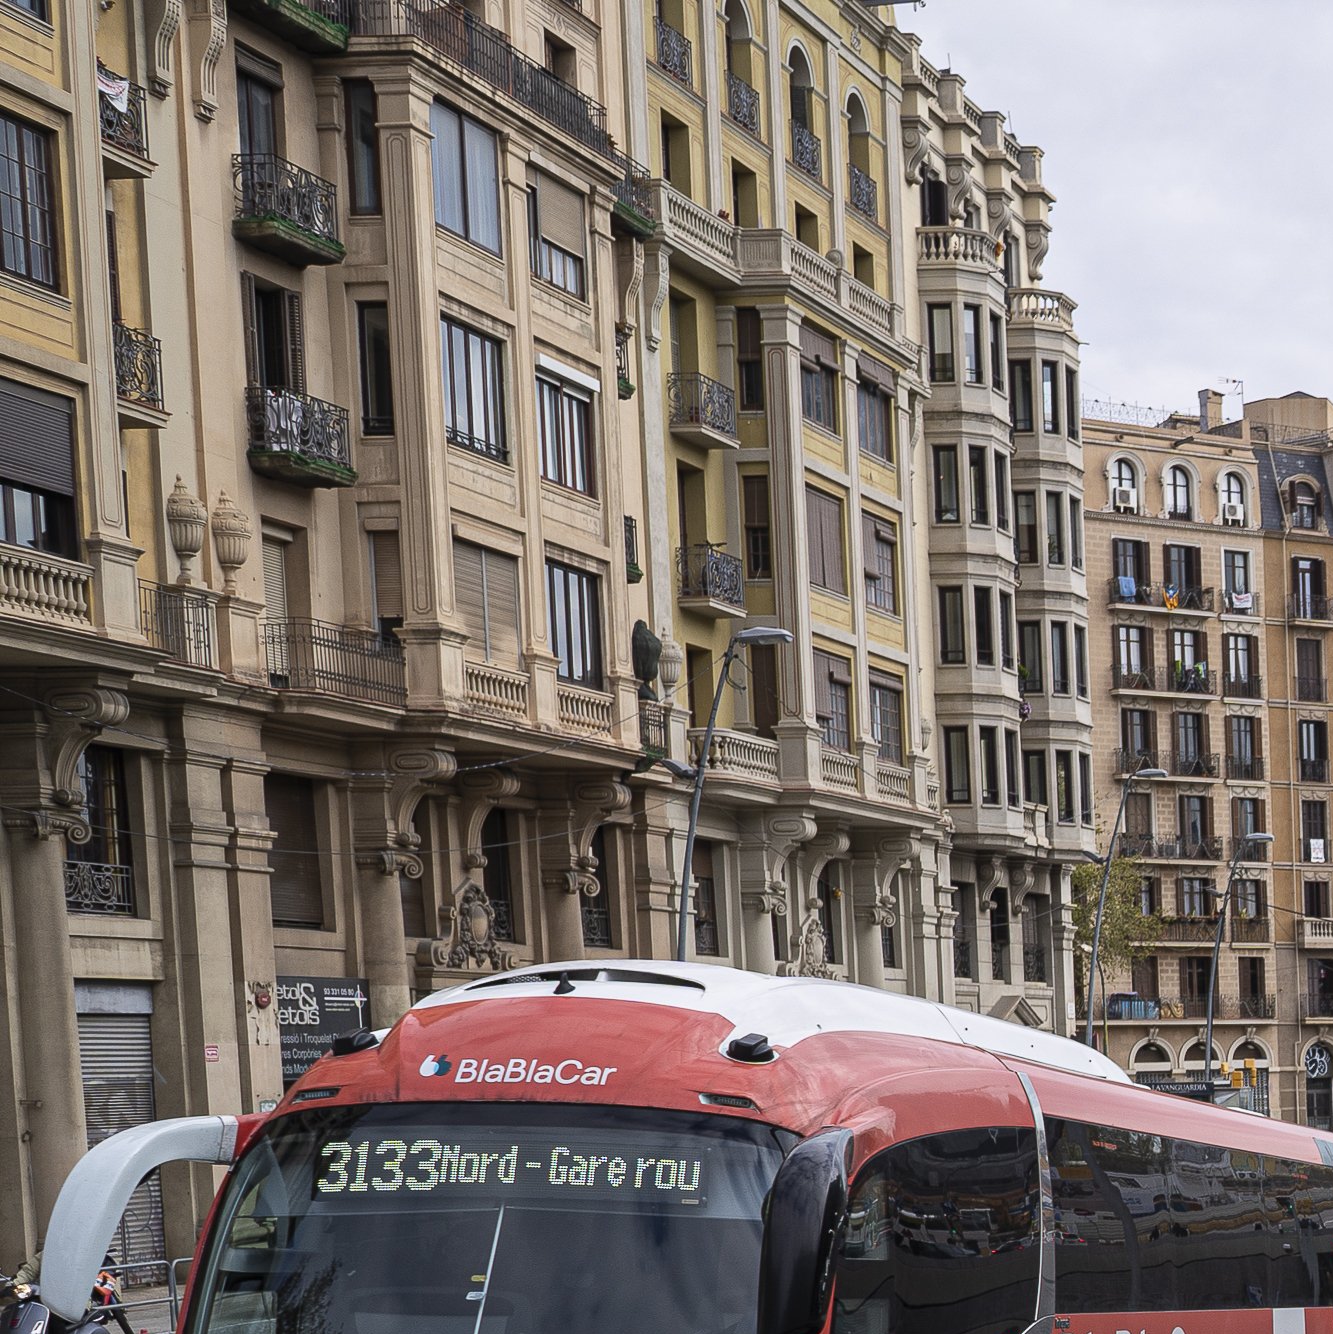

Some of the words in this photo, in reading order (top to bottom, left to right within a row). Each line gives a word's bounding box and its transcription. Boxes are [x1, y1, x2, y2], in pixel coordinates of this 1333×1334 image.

[454, 1058, 617, 1086] BlaBlaCar
[317, 1140, 441, 1194] 3133
[441, 1144, 519, 1185] Nord
[548, 1146, 627, 1189] Gare
